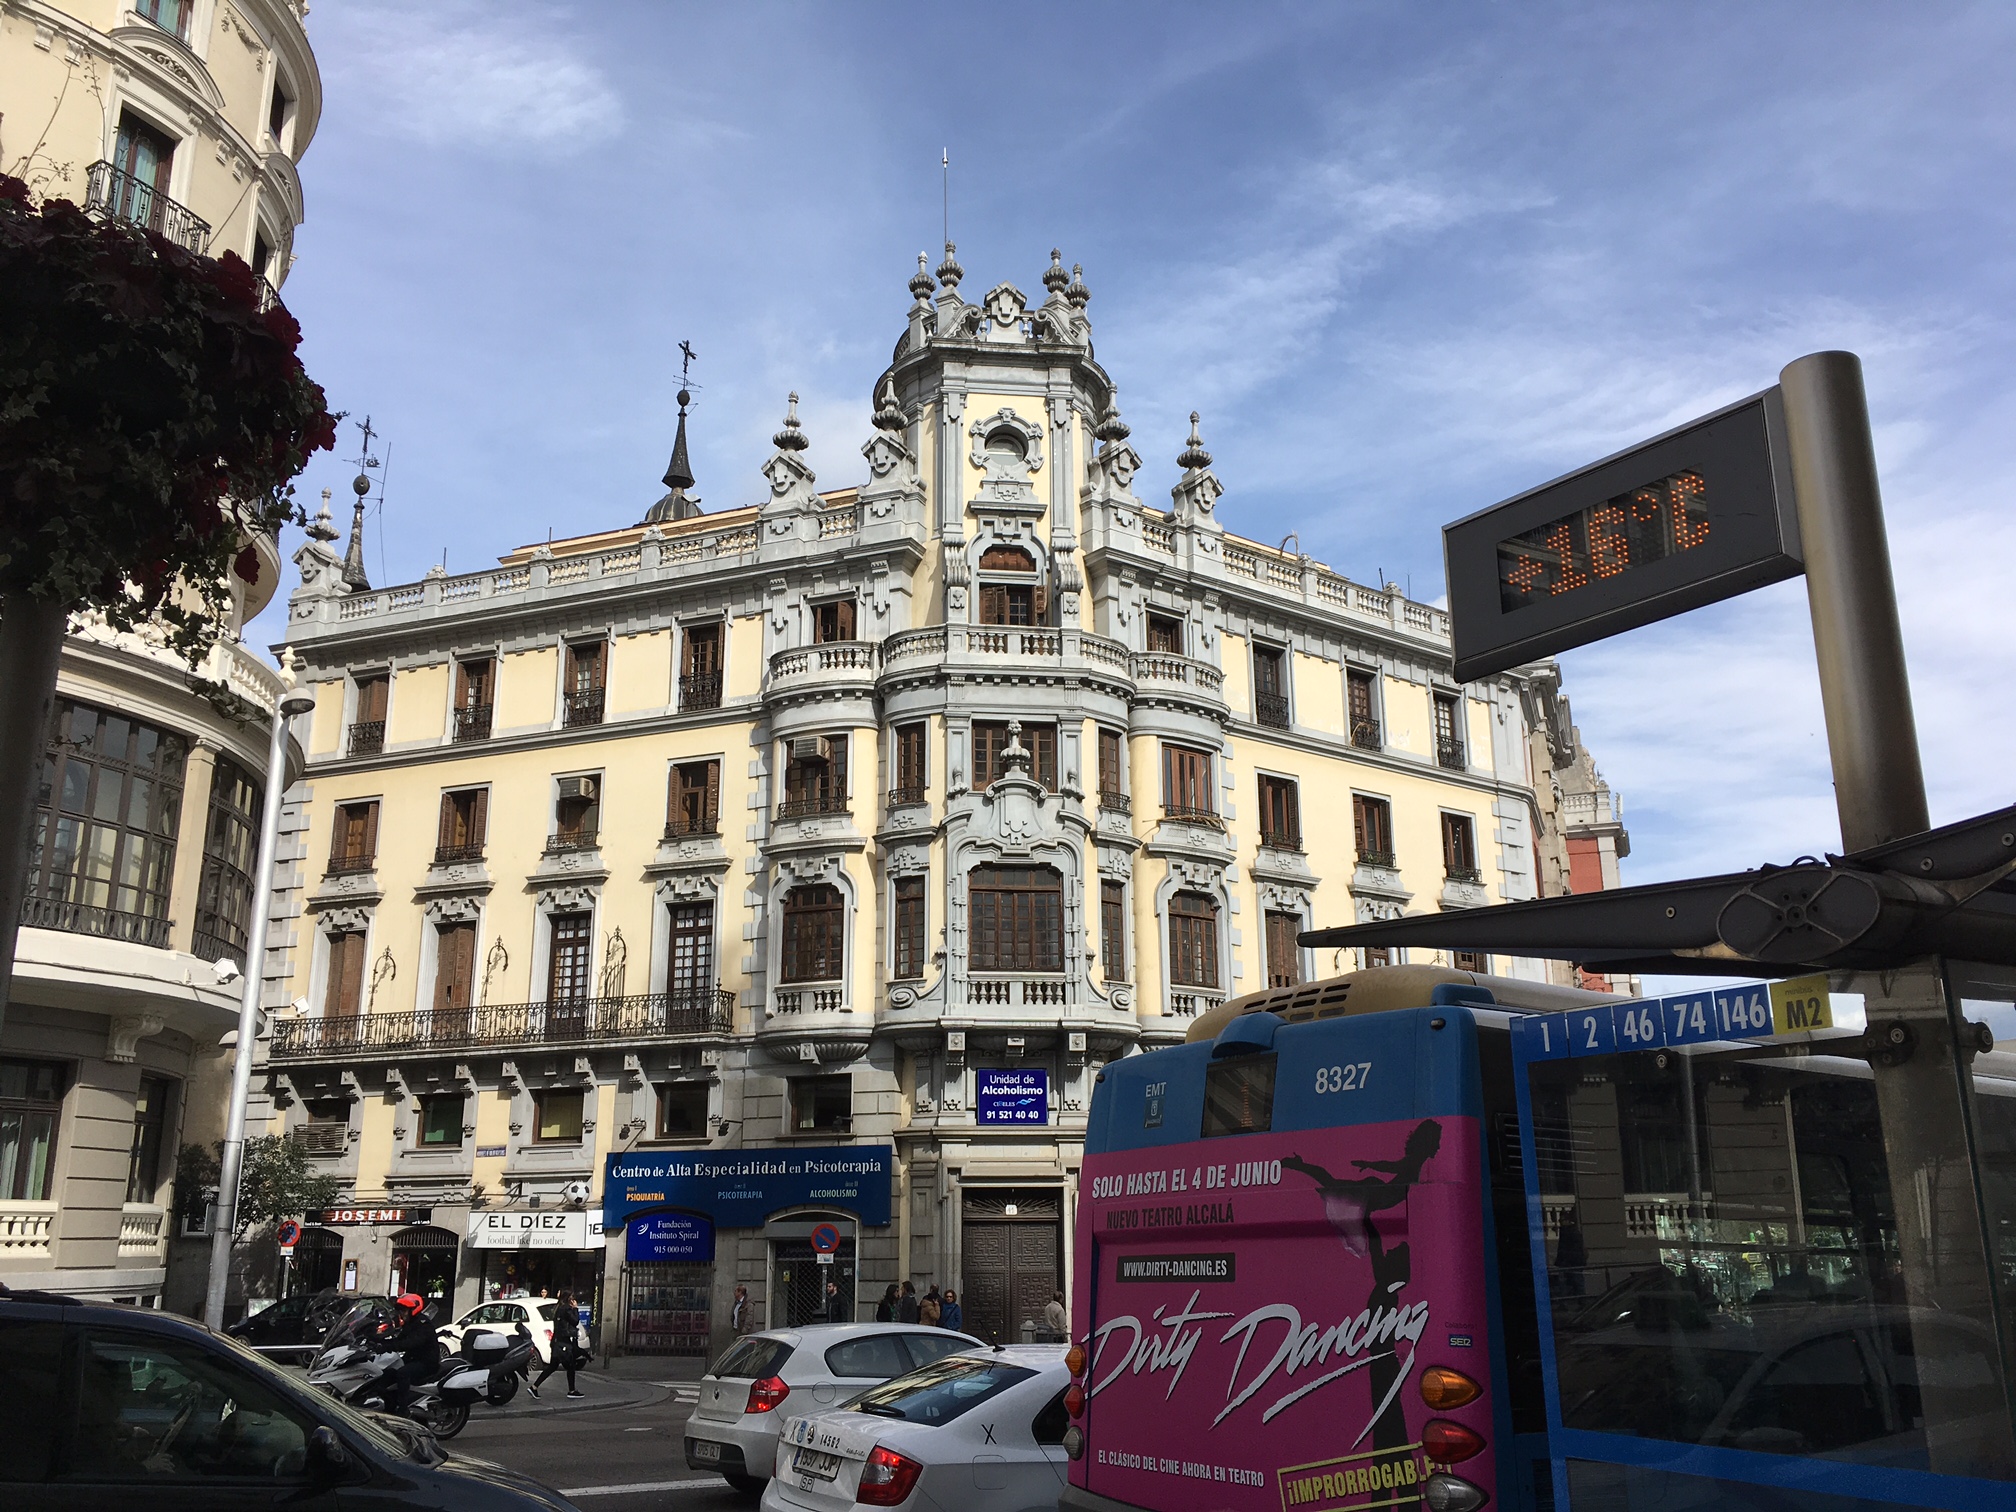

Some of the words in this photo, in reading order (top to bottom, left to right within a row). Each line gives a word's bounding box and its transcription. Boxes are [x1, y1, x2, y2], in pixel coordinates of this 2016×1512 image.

[1786, 997, 1823, 1030] M2
[1540, 1022, 1551, 1052] 1
[1583, 1016, 1598, 1049] 2
[1624, 1008, 1655, 1043] 46
[1673, 1001, 1707, 1038] 74
[1718, 993, 1767, 1032] 146
[989, 1075, 1020, 1084] Unidad
[1023, 1075, 1035, 1084] de
[1315, 1062, 1372, 1094] 8327
[982, 1086, 1043, 1095] Alcoholismo
[1145, 1082, 1166, 1097] EMT
[986, 1111, 996, 1119] 91
[999, 1111, 1012, 1119] 521
[1015, 1111, 1026, 1119] 40
[1028, 1111, 1039, 1119] 40
[612, 1165, 651, 1178] Centro
[653, 1166, 664, 1177] de
[666, 1163, 691, 1177] Alta
[694, 1161, 786, 1178] Especialidad
[789, 1165, 801, 1174] en
[805, 1159, 881, 1175] Psicoterapia
[1092, 1174, 1123, 1199] SOLO
[1126, 1170, 1167, 1196] HASTA
[1171, 1168, 1187, 1192] EL
[1192, 1167, 1201, 1190] 4
[1206, 1164, 1226, 1189] DE
[1230, 1159, 1282, 1187] JUNIO
[626, 1191, 665, 1201] PSIQUIATRÍA
[718, 1190, 763, 1200] PSICOTERAPIA
[809, 1189, 858, 1198] ALCOHOLISMO
[331, 1210, 402, 1222] JOSEMI
[1106, 1209, 1139, 1229] NUEVO
[1142, 1206, 1182, 1227] TEATRO
[1186, 1198, 1234, 1225] ALCALÁ
[488, 1216, 512, 1228] EL
[520, 1216, 566, 1229] DIEZ
[657, 1220, 692, 1229] Fundación
[487, 1235, 515, 1245] football
[517, 1236, 530, 1245] like
[532, 1237, 543, 1245] no
[544, 1236, 565, 1245] other
[649, 1231, 678, 1240] Instituto
[678, 1231, 699, 1241] Spiral
[654, 1245, 667, 1253] 915
[1123, 1259, 1227, 1277] WWW.DIRTY-DANCING.ES
[1081, 1289, 1235, 1400] Dirty
[1208, 1282, 1429, 1451] Dancing
[820, 1434, 840, 1449] 14562
[1098, 1450, 1107, 1464] EL
[1108, 1450, 1140, 1469] CLÁSICO
[1143, 1456, 1158, 1472] DEL
[1160, 1458, 1179, 1475] CINE
[1182, 1461, 1212, 1480] AHORA
[1214, 1466, 1226, 1482] EN
[1228, 1468, 1264, 1488] TEATRO
[801, 1477, 813, 1489] SP
